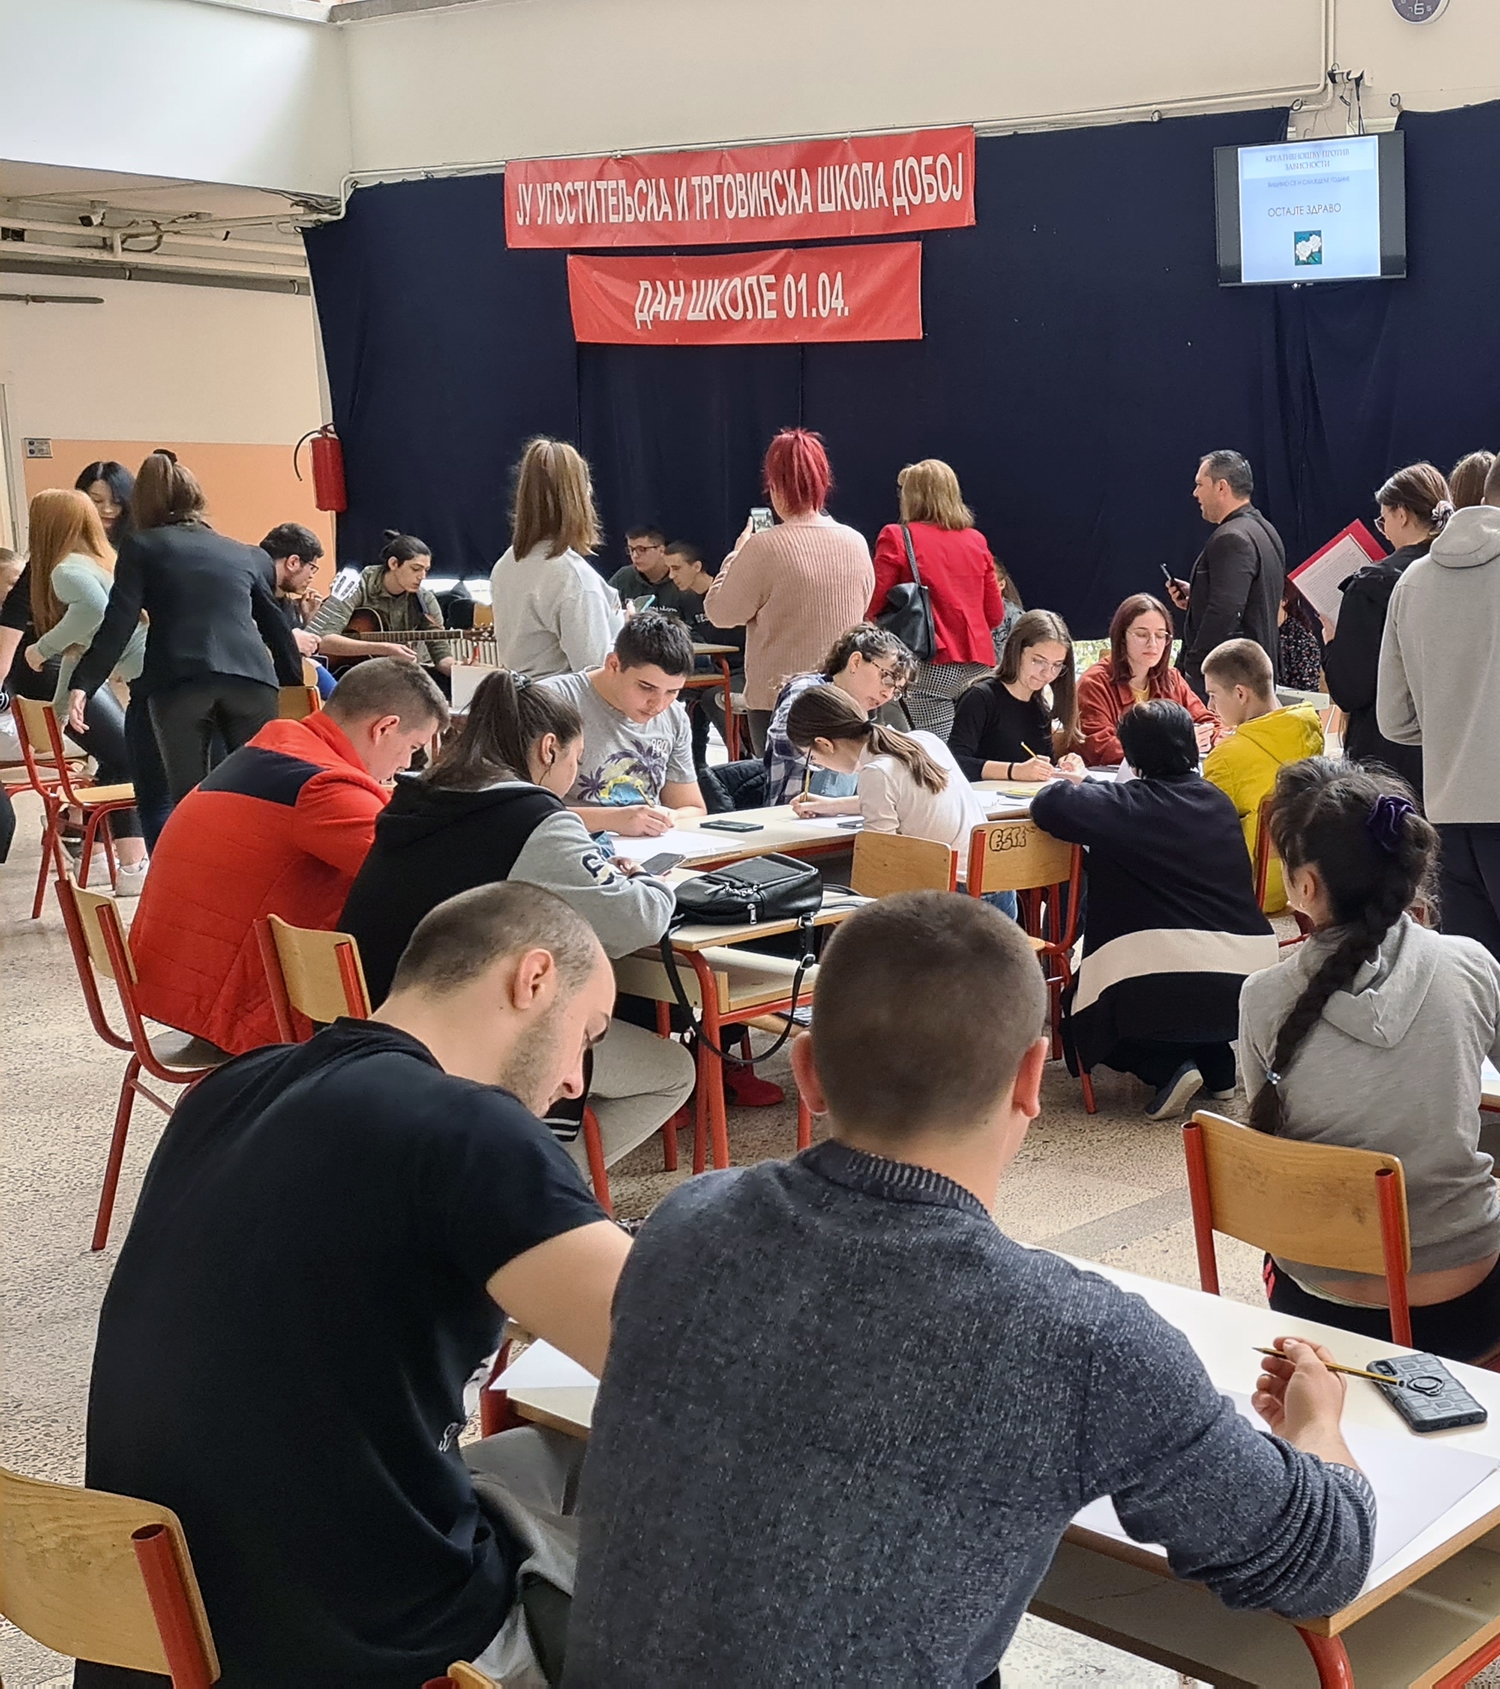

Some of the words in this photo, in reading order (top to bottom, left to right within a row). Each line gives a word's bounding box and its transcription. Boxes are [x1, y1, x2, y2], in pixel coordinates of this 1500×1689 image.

[536, 178, 673, 226] УГОСТИТЕЉСКА
[674, 177, 689, 221] И
[691, 168, 813, 221] ТРГОВИНСКА
[817, 162, 889, 213] ШКОЛА
[892, 152, 963, 216] ДОБОЈ
[1267, 206, 1304, 218] ОСТАЈТЕ
[1306, 202, 1342, 215] ЗДРАВО
[634, 280, 685, 330] ДАН
[687, 275, 777, 321] ШКОЛЕ
[783, 271, 849, 319] 01.04.
